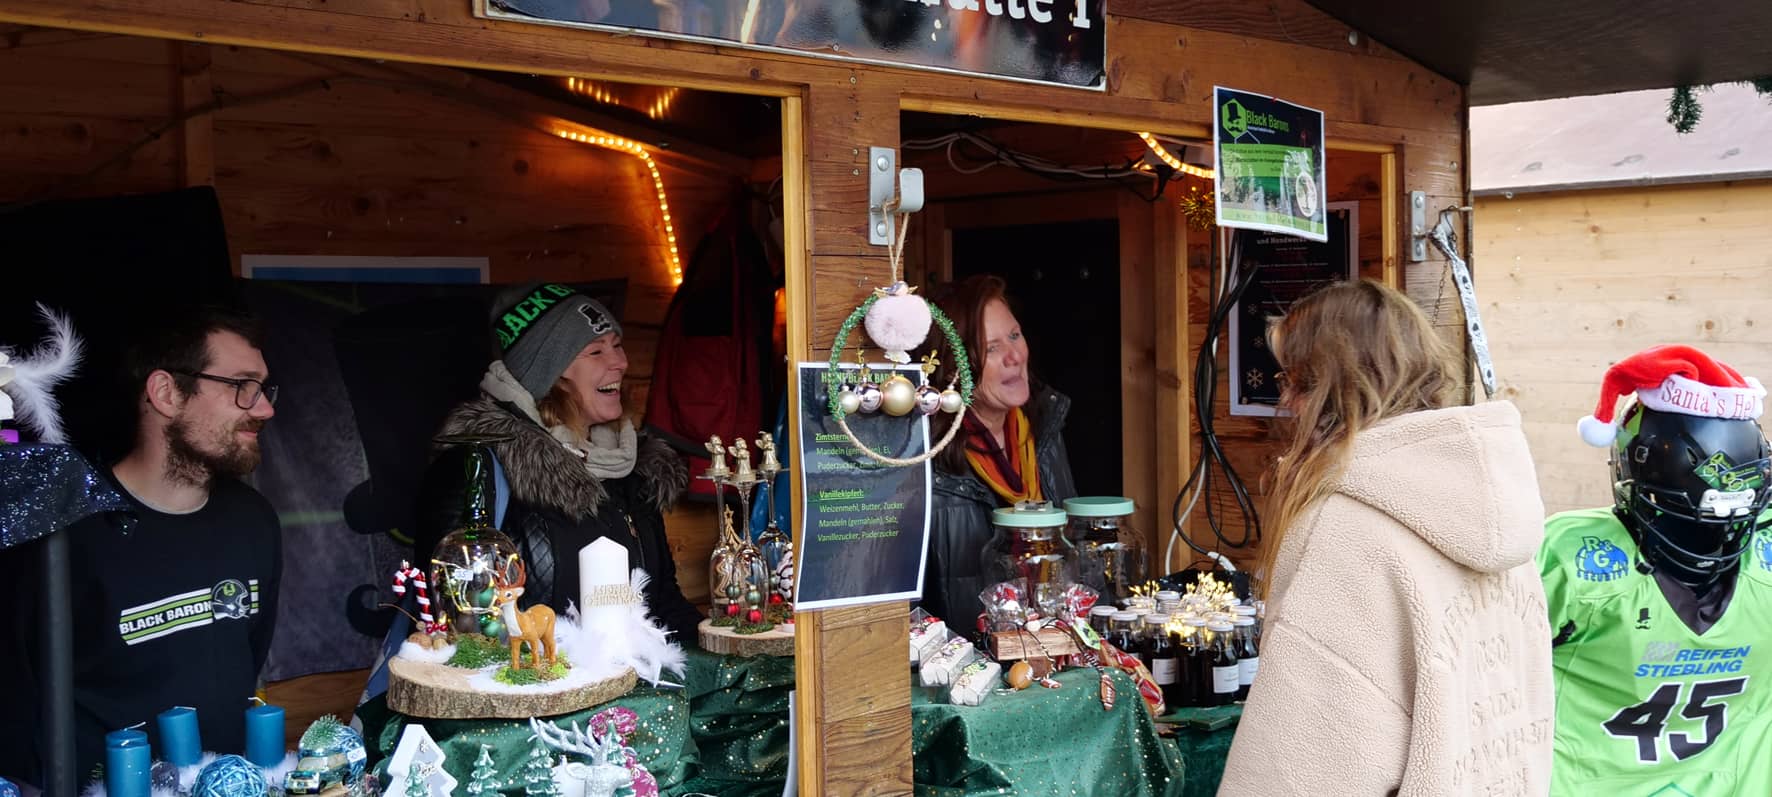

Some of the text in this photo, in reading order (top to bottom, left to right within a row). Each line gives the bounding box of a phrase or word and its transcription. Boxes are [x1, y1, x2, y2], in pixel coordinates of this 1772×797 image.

[1246, 110, 1267, 127] Black
[1661, 378, 1726, 416] Santa's
[816, 447, 843, 456] Mandeln
[819, 488, 864, 500] Vanillekipferl:
[820, 503, 859, 513] Weizenmehl,
[861, 503, 881, 511] Butter,
[818, 519, 848, 528] Mandeln
[817, 530, 898, 542] Vanillezucker, Puderzucker
[1583, 536, 1600, 551] R
[1592, 550, 1610, 568] G
[120, 600, 212, 634] BLACK BARON
[1674, 645, 1751, 662] REIFEN
[1634, 659, 1743, 677] STIEBLING
[1600, 675, 1750, 763] 45
